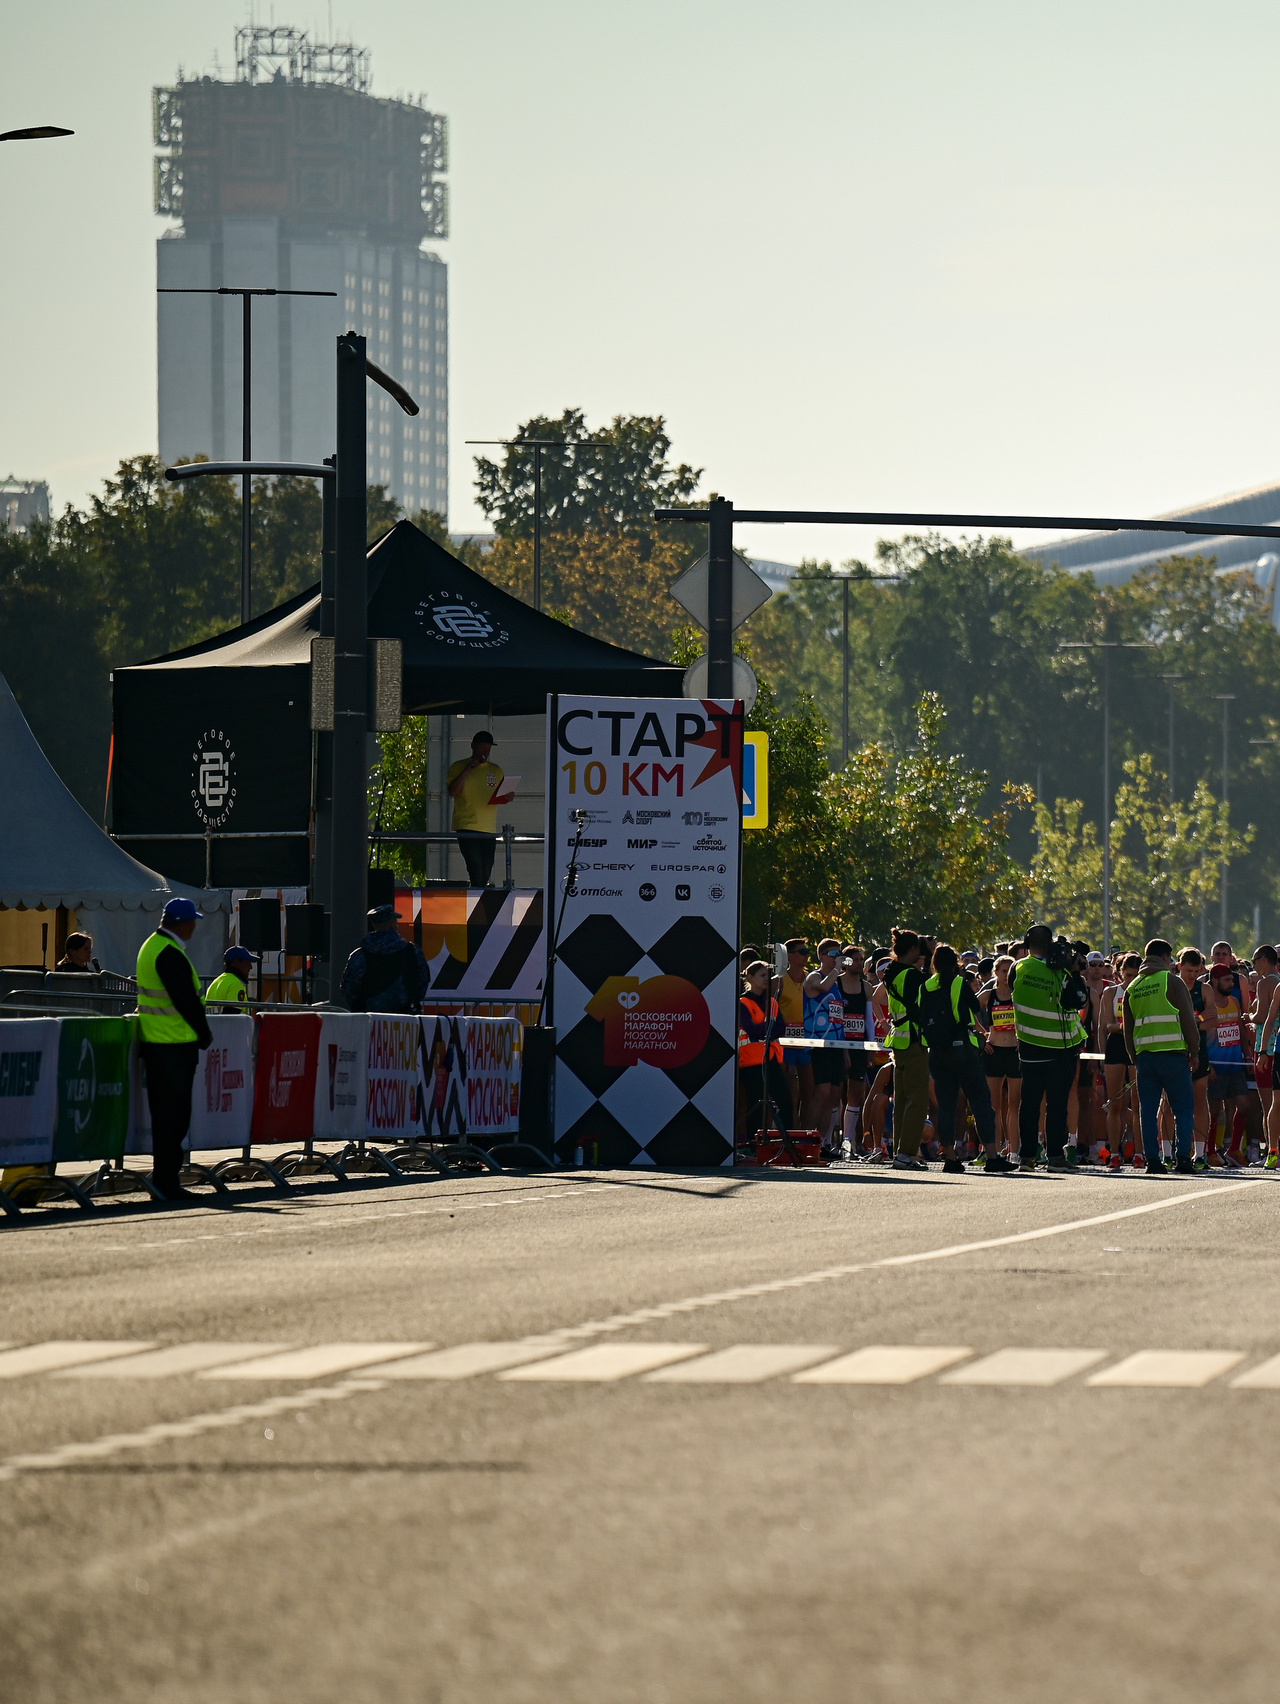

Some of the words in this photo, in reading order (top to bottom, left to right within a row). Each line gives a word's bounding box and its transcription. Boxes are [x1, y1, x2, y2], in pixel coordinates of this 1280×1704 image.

[426, 630, 509, 648] СООБЩЕСТВО
[558, 710, 743, 758] СТАРТ
[193, 729, 236, 762] БЕГОВОЕ
[562, 761, 607, 795] 10
[622, 762, 684, 797] КМ
[191, 788, 237, 828] СООБЩЕСТВО
[636, 818, 652, 826] СПОРТ
[681, 811, 703, 826] 100
[567, 838, 607, 848] СИБУР
[627, 839, 658, 849] МИР
[593, 863, 635, 871] CHERY
[651, 864, 715, 872] EUROSPAR
[677, 888, 689, 897] VK
[624, 1011, 693, 1022] МОСКОВСКИЙ
[624, 1022, 674, 1031] МАРАФОН
[843, 1020, 864, 1028] 28019
[624, 1032, 668, 1040] MOSCOW
[1218, 1029, 1239, 1038] 40478
[368, 1020, 419, 1071] MARATHON
[468, 1022, 523, 1071] МАРАФОН
[624, 1041, 677, 1050] MARATHON
[367, 1078, 407, 1129] MOSCOW
[468, 1078, 510, 1126] МОСКВА
